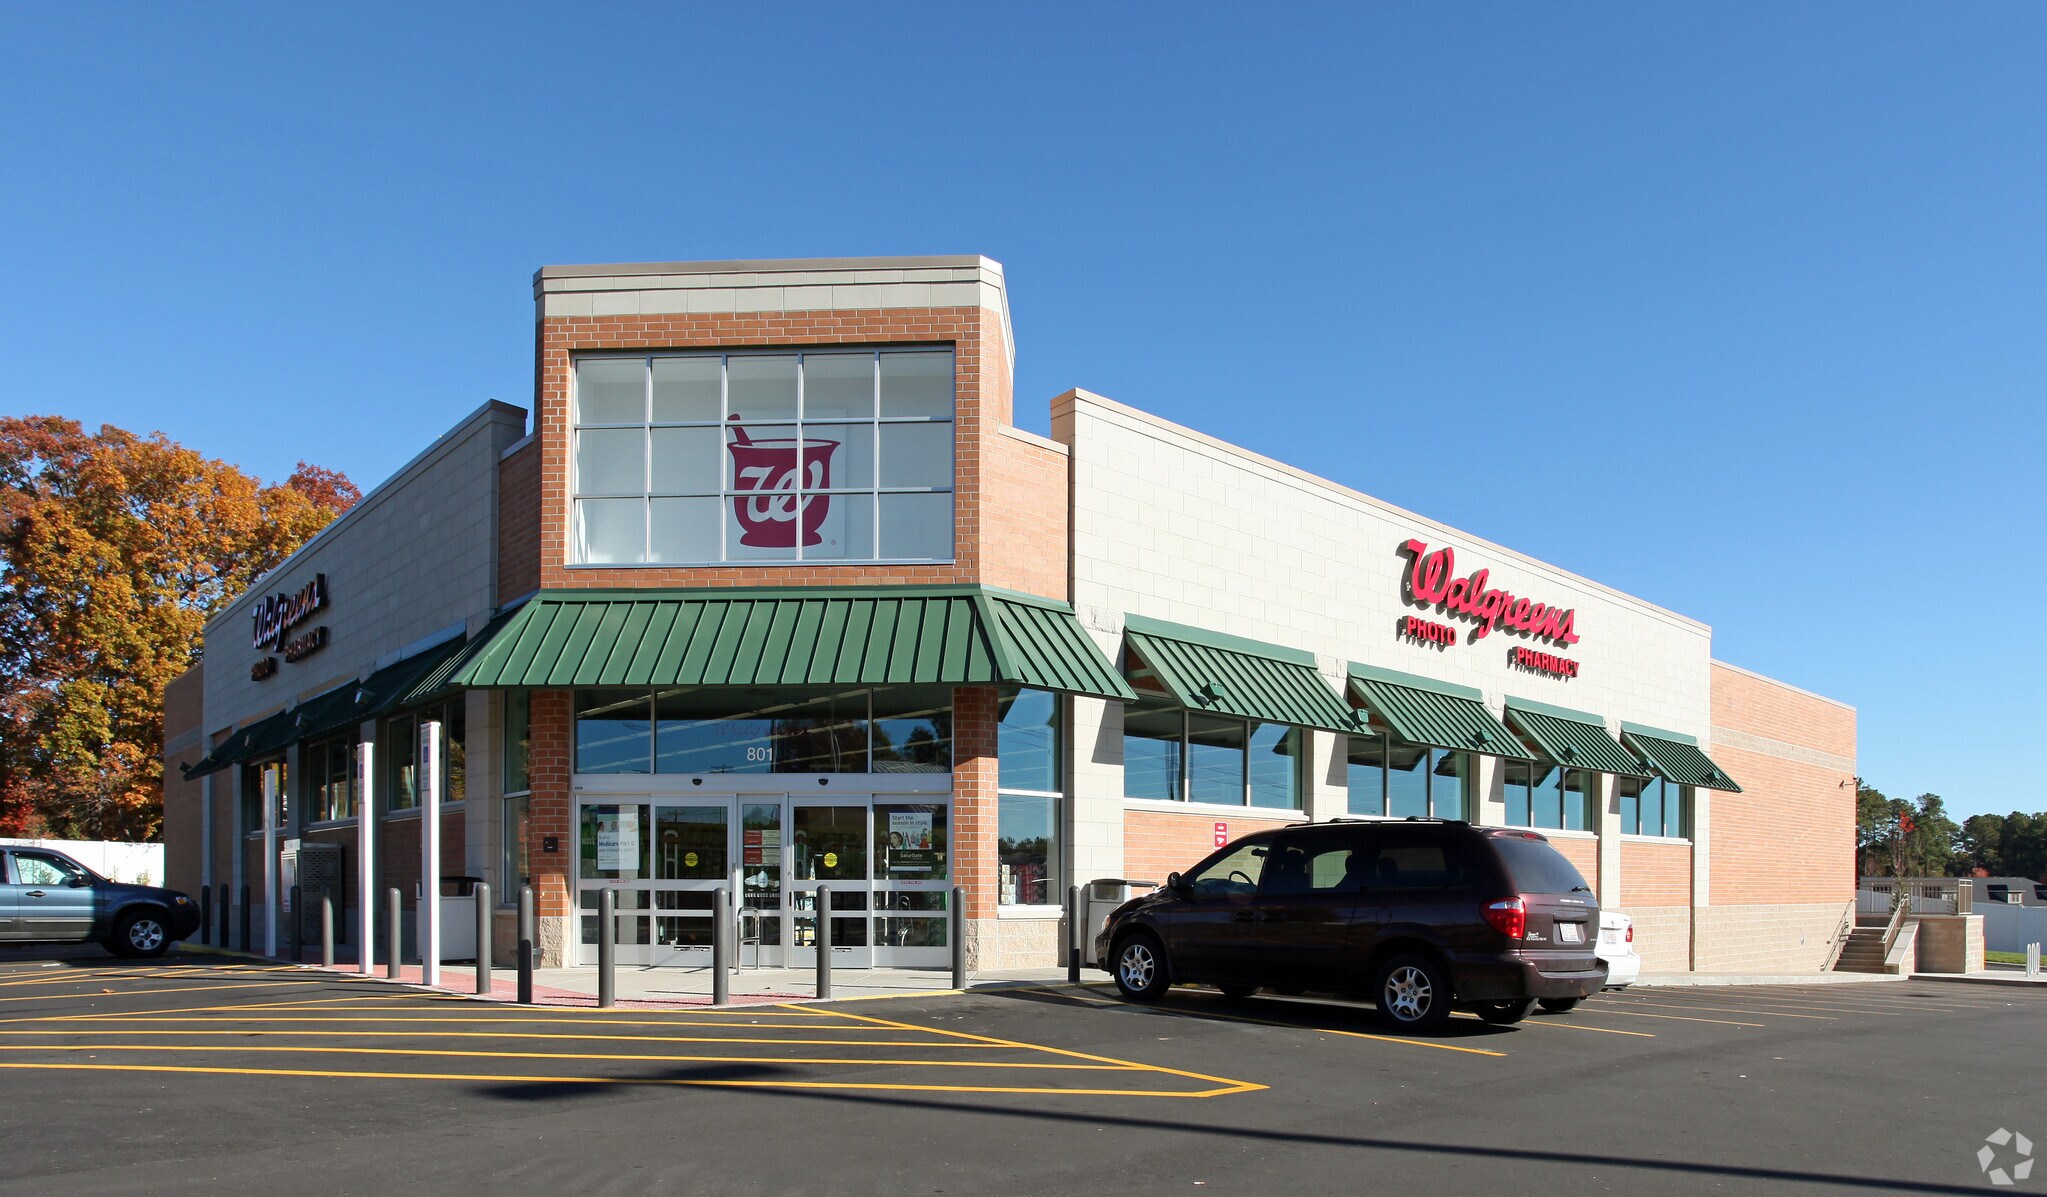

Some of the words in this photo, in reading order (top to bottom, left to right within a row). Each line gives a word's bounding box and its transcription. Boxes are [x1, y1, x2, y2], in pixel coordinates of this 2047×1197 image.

[1404, 538, 1581, 645] Walgreens
[1405, 615, 1457, 647] PHOTO
[1515, 645, 1580, 679] PHARMACY
[746, 747, 773, 762] 801
